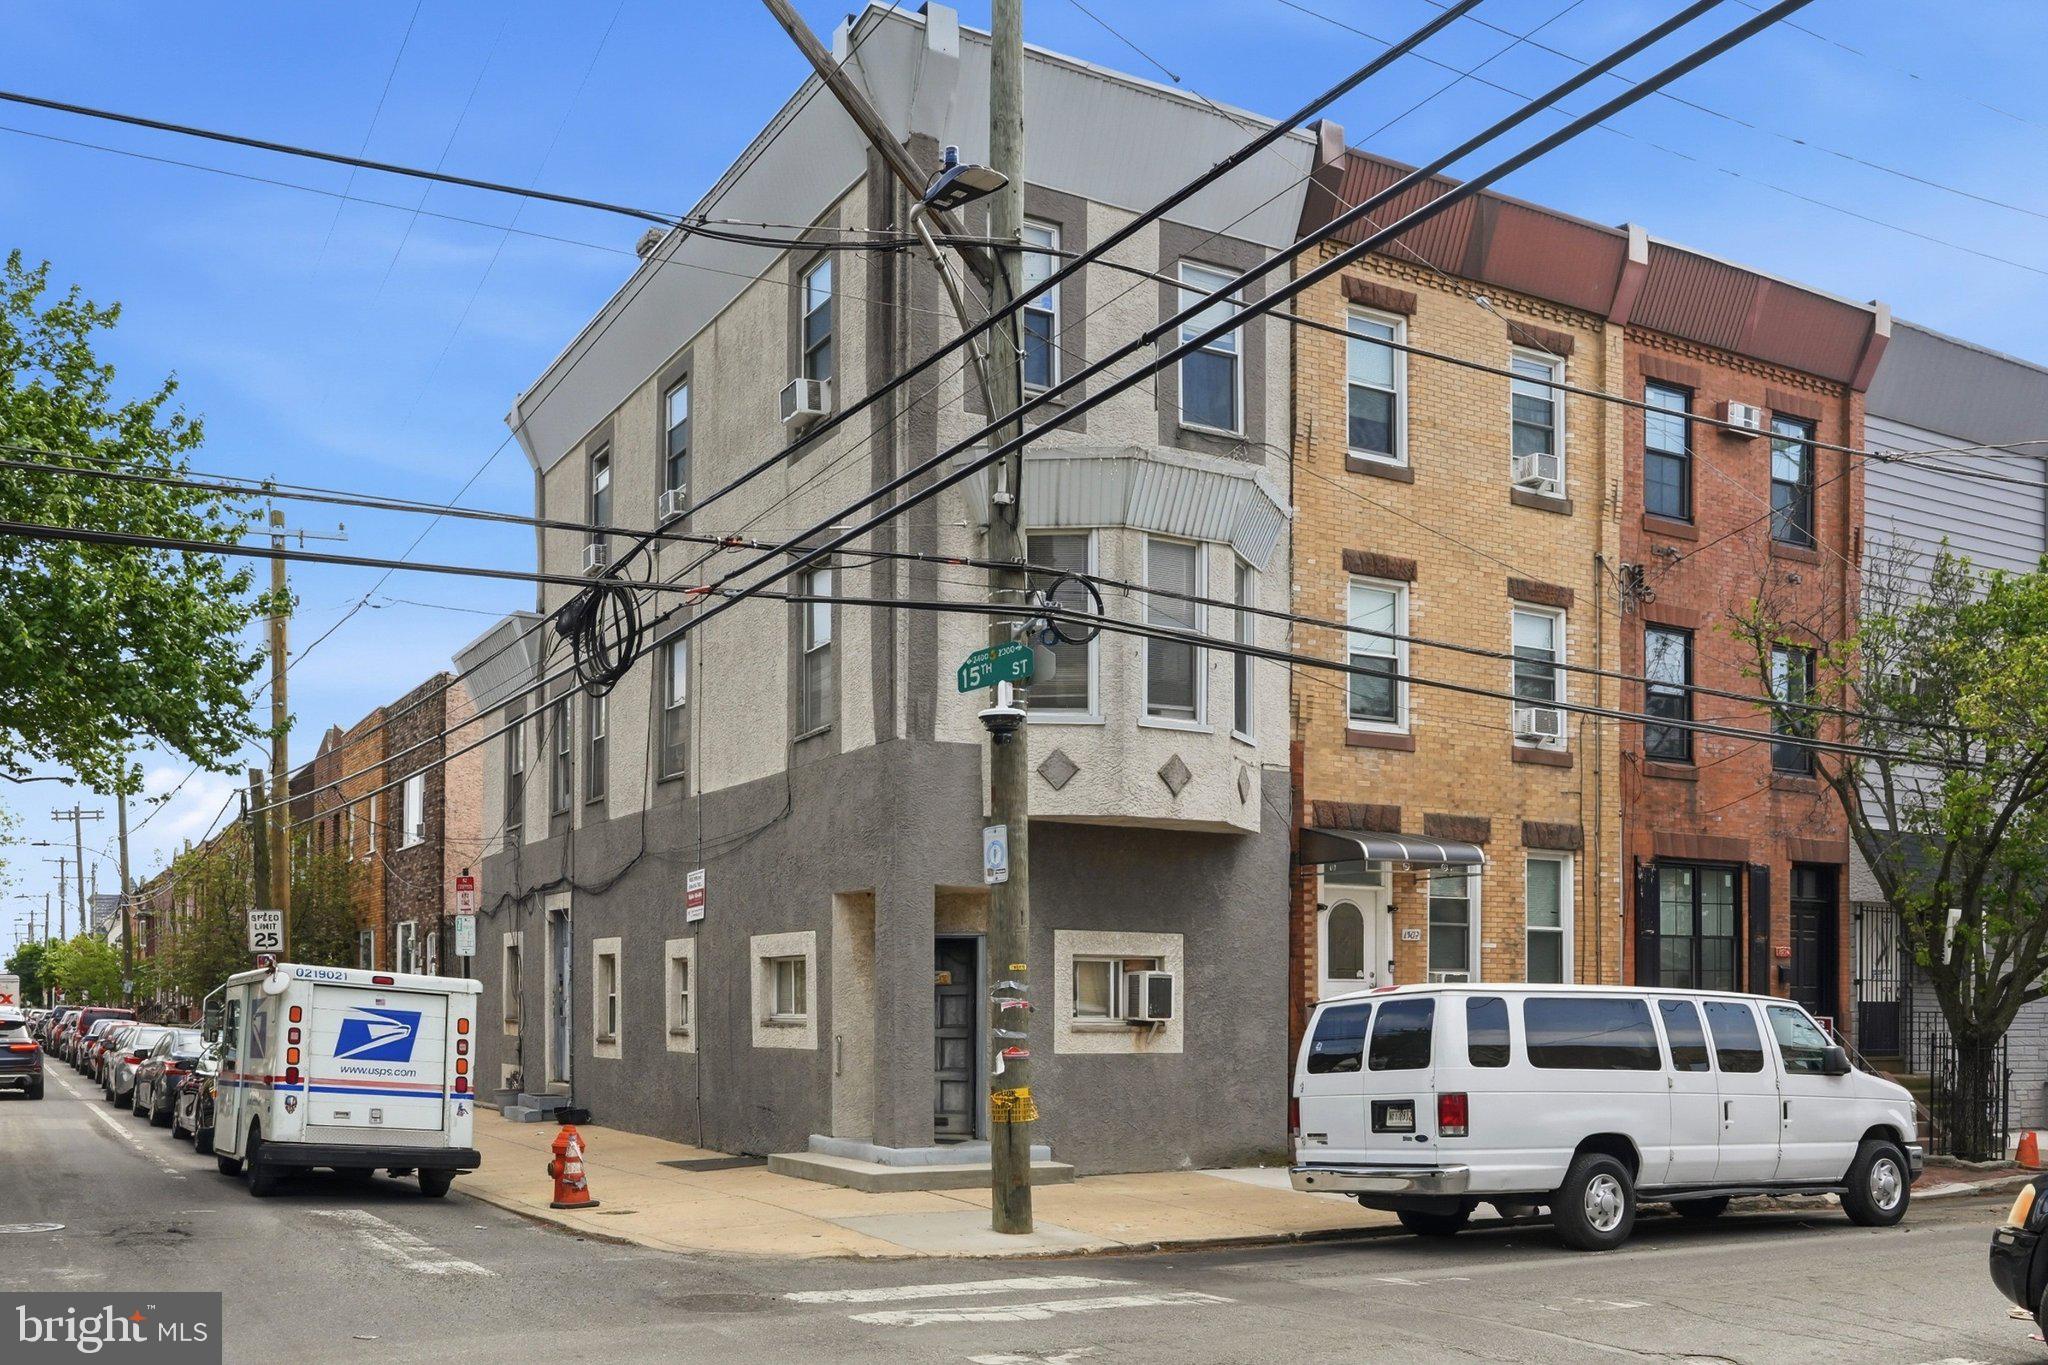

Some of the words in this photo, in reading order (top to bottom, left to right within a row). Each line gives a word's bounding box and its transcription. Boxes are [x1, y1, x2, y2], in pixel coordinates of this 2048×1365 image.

[962, 663, 992, 688] 15TH
[1012, 659, 1028, 675] ST
[251, 914, 280, 922] SPEED
[254, 932, 279, 947] 25
[295, 967, 348, 981] 0219021
[340, 1065, 417, 1078] www.usps.com
